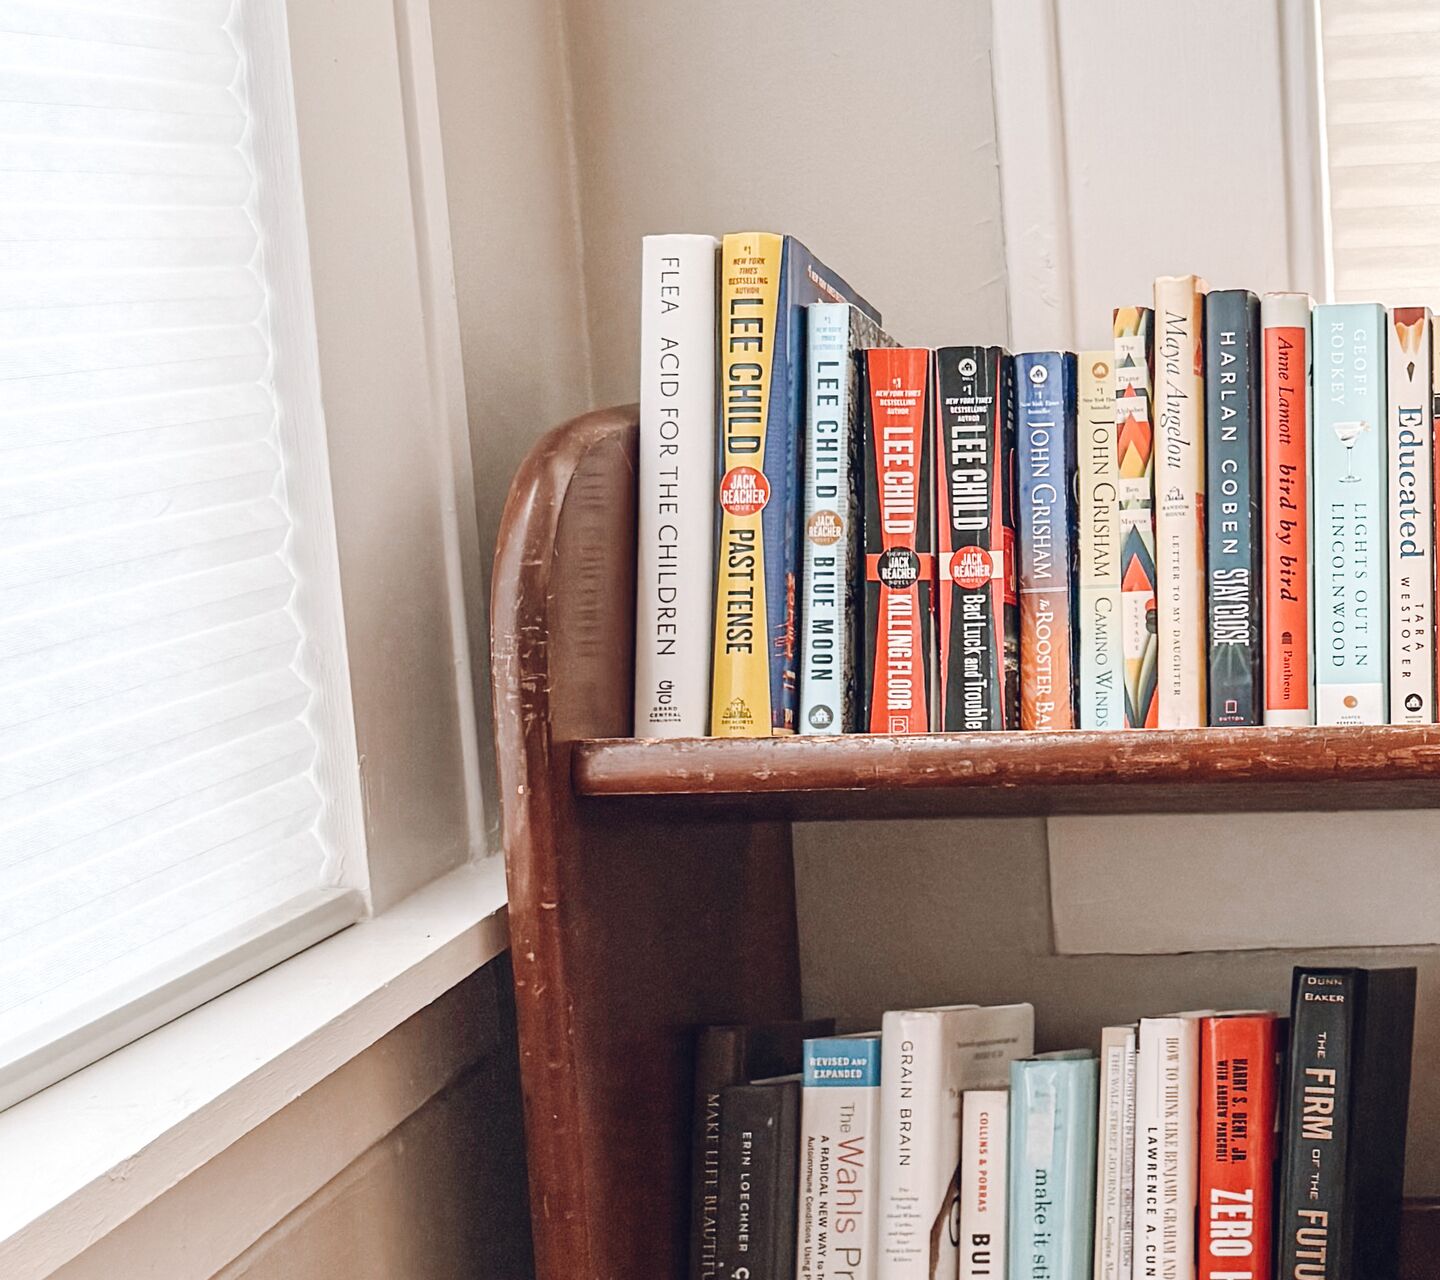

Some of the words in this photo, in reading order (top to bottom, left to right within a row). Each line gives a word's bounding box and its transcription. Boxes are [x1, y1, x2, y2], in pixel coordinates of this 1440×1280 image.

[661, 258, 679, 314] FLEA
[729, 277, 768, 285] BESTSELLING
[730, 299, 764, 353] LEE
[1161, 312, 1187, 375] Maya
[661, 337, 679, 397] ACID
[817, 362, 839, 406] LEE
[1220, 332, 1236, 441] HARLAN
[660, 409, 679, 457] FOR
[728, 363, 763, 453] CHILD
[1161, 384, 1190, 469] Angelou
[816, 420, 839, 498] CHILD
[884, 427, 914, 467] LEE
[952, 426, 986, 465] LEE
[1027, 422, 1055, 477] JOHN
[1090, 420, 1114, 475] JOHN
[659, 466, 679, 514] THE
[723, 490, 765, 504] REACHER
[730, 475, 756, 489] JACK
[884, 472, 914, 534] CHILD
[952, 469, 988, 530] CHILD
[1222, 459, 1238, 554] COBEN
[1398, 405, 1425, 559] Educated
[728, 530, 755, 580] PAST
[1031, 484, 1056, 579] GRISHAM
[1093, 483, 1116, 577] GRISHAM
[813, 557, 835, 607] BLUE
[882, 568, 916, 579] REACHER
[889, 557, 909, 568] JACK
[954, 566, 989, 577] REACHER
[961, 553, 982, 565] JACK
[1332, 503, 1345, 667] LINCOLNWOOD
[657, 525, 678, 655] CHILDREN
[726, 591, 753, 654] TENSE
[811, 620, 834, 680] MOON
[1095, 598, 1112, 665] CAMINO
[1401, 577, 1411, 678] WESTOVER
[1416, 604, 1424, 651] TARA
[1095, 671, 1113, 728] WINDS
[1304, 993, 1344, 1002] BAKER
[814, 1070, 862, 1079] EXPANDED
[901, 1041, 913, 1099] GRAIN
[840, 1102, 855, 1133] The
[899, 1108, 912, 1166] BRAIN
[742, 1132, 752, 1166] ERIN
[738, 1173, 750, 1252] LOECHNER
[835, 1136, 865, 1233] Wahls
[1035, 1168, 1052, 1225] make
[1033, 1233, 1051, 1249] it
[1209, 1189, 1254, 1257] ZERO
